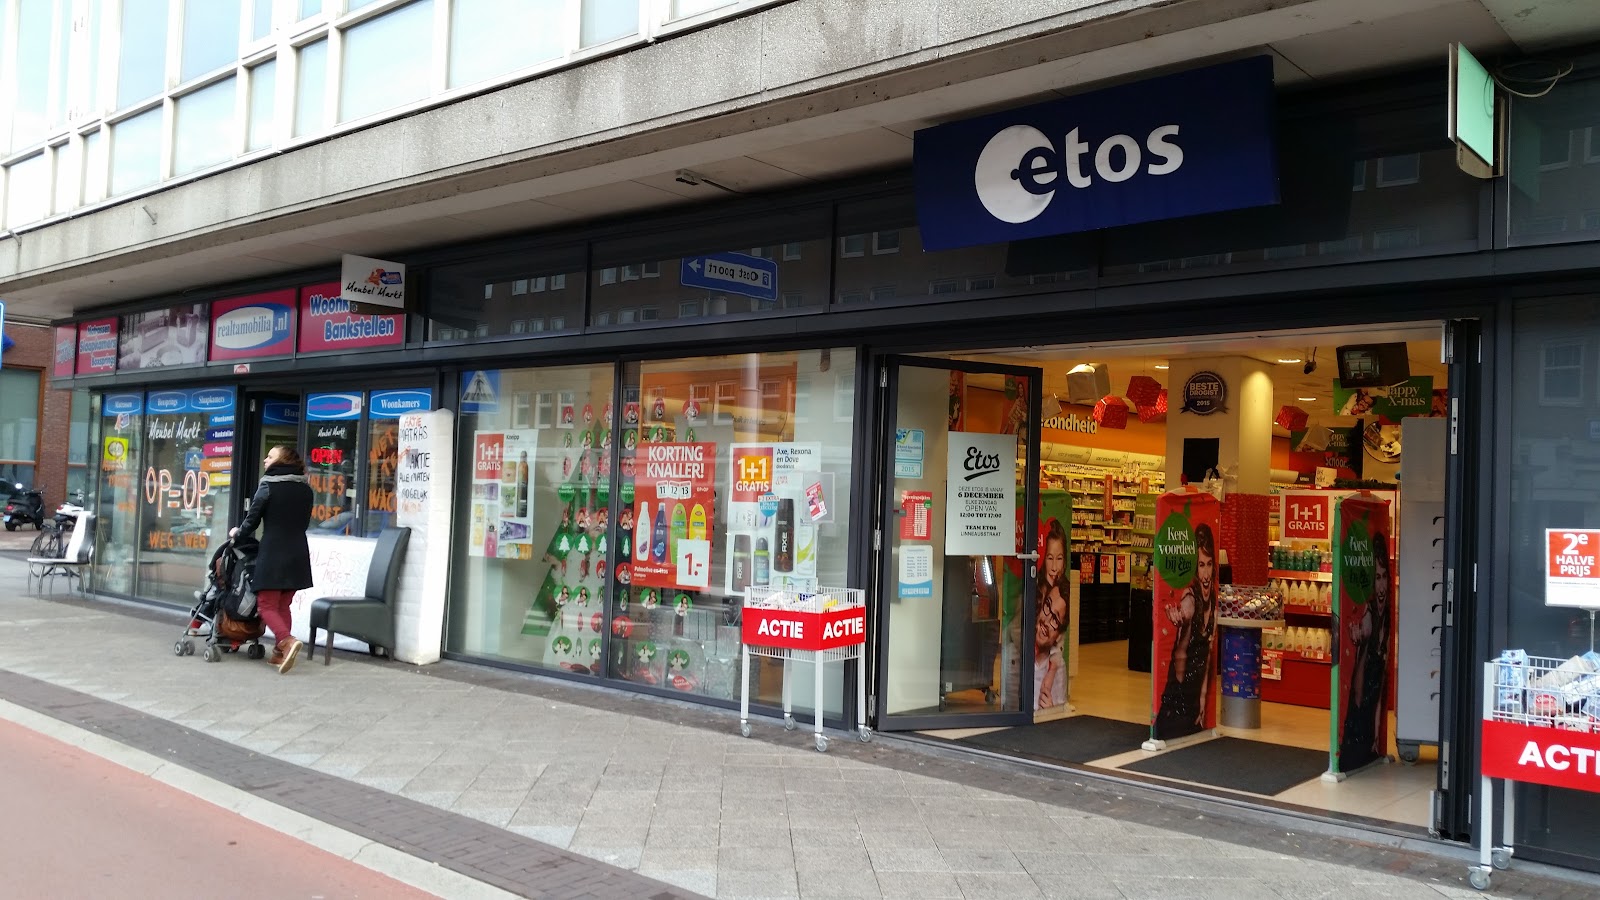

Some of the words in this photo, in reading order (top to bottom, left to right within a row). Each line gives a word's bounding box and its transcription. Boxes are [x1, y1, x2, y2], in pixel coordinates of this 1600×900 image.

[1014, 124, 1184, 197] etos
[345, 281, 375, 295] Meubel
[377, 286, 403, 299] Markt
[310, 294, 351, 317] Woonk
[324, 316, 395, 341] Bankstellen
[1190, 382, 1219, 390] BESTE
[381, 399, 420, 409] Woonkamers
[1388, 394, 1426, 407] X-mas
[148, 417, 175, 439] Meubel
[175, 416, 201, 439] Markt
[311, 448, 343, 464] OPEN
[480, 442, 500, 461] 1+1
[648, 445, 703, 462] KORTING
[963, 446, 1000, 471] Etos
[409, 452, 431, 470] AKTIE
[477, 461, 501, 471] GRATIS
[738, 457, 767, 480] 1+1
[646, 462, 705, 479] KNALLER!
[659, 486, 666, 494] 11
[671, 486, 678, 495] 12
[681, 487, 689, 495] 13
[735, 480, 769, 492] GRATIS
[1290, 503, 1322, 521] 1+1
[1167, 526, 1189, 541] Kerst
[1288, 520, 1326, 531] GRATIS
[1158, 541, 1196, 555] voordeel
[1562, 533, 1589, 555] 2e
[1165, 556, 1176, 573] bij
[1556, 555, 1595, 566] HALVE
[1560, 565, 1591, 577] PRIJS
[757, 618, 804, 639] ACTIE
[822, 617, 864, 640] ACTIE
